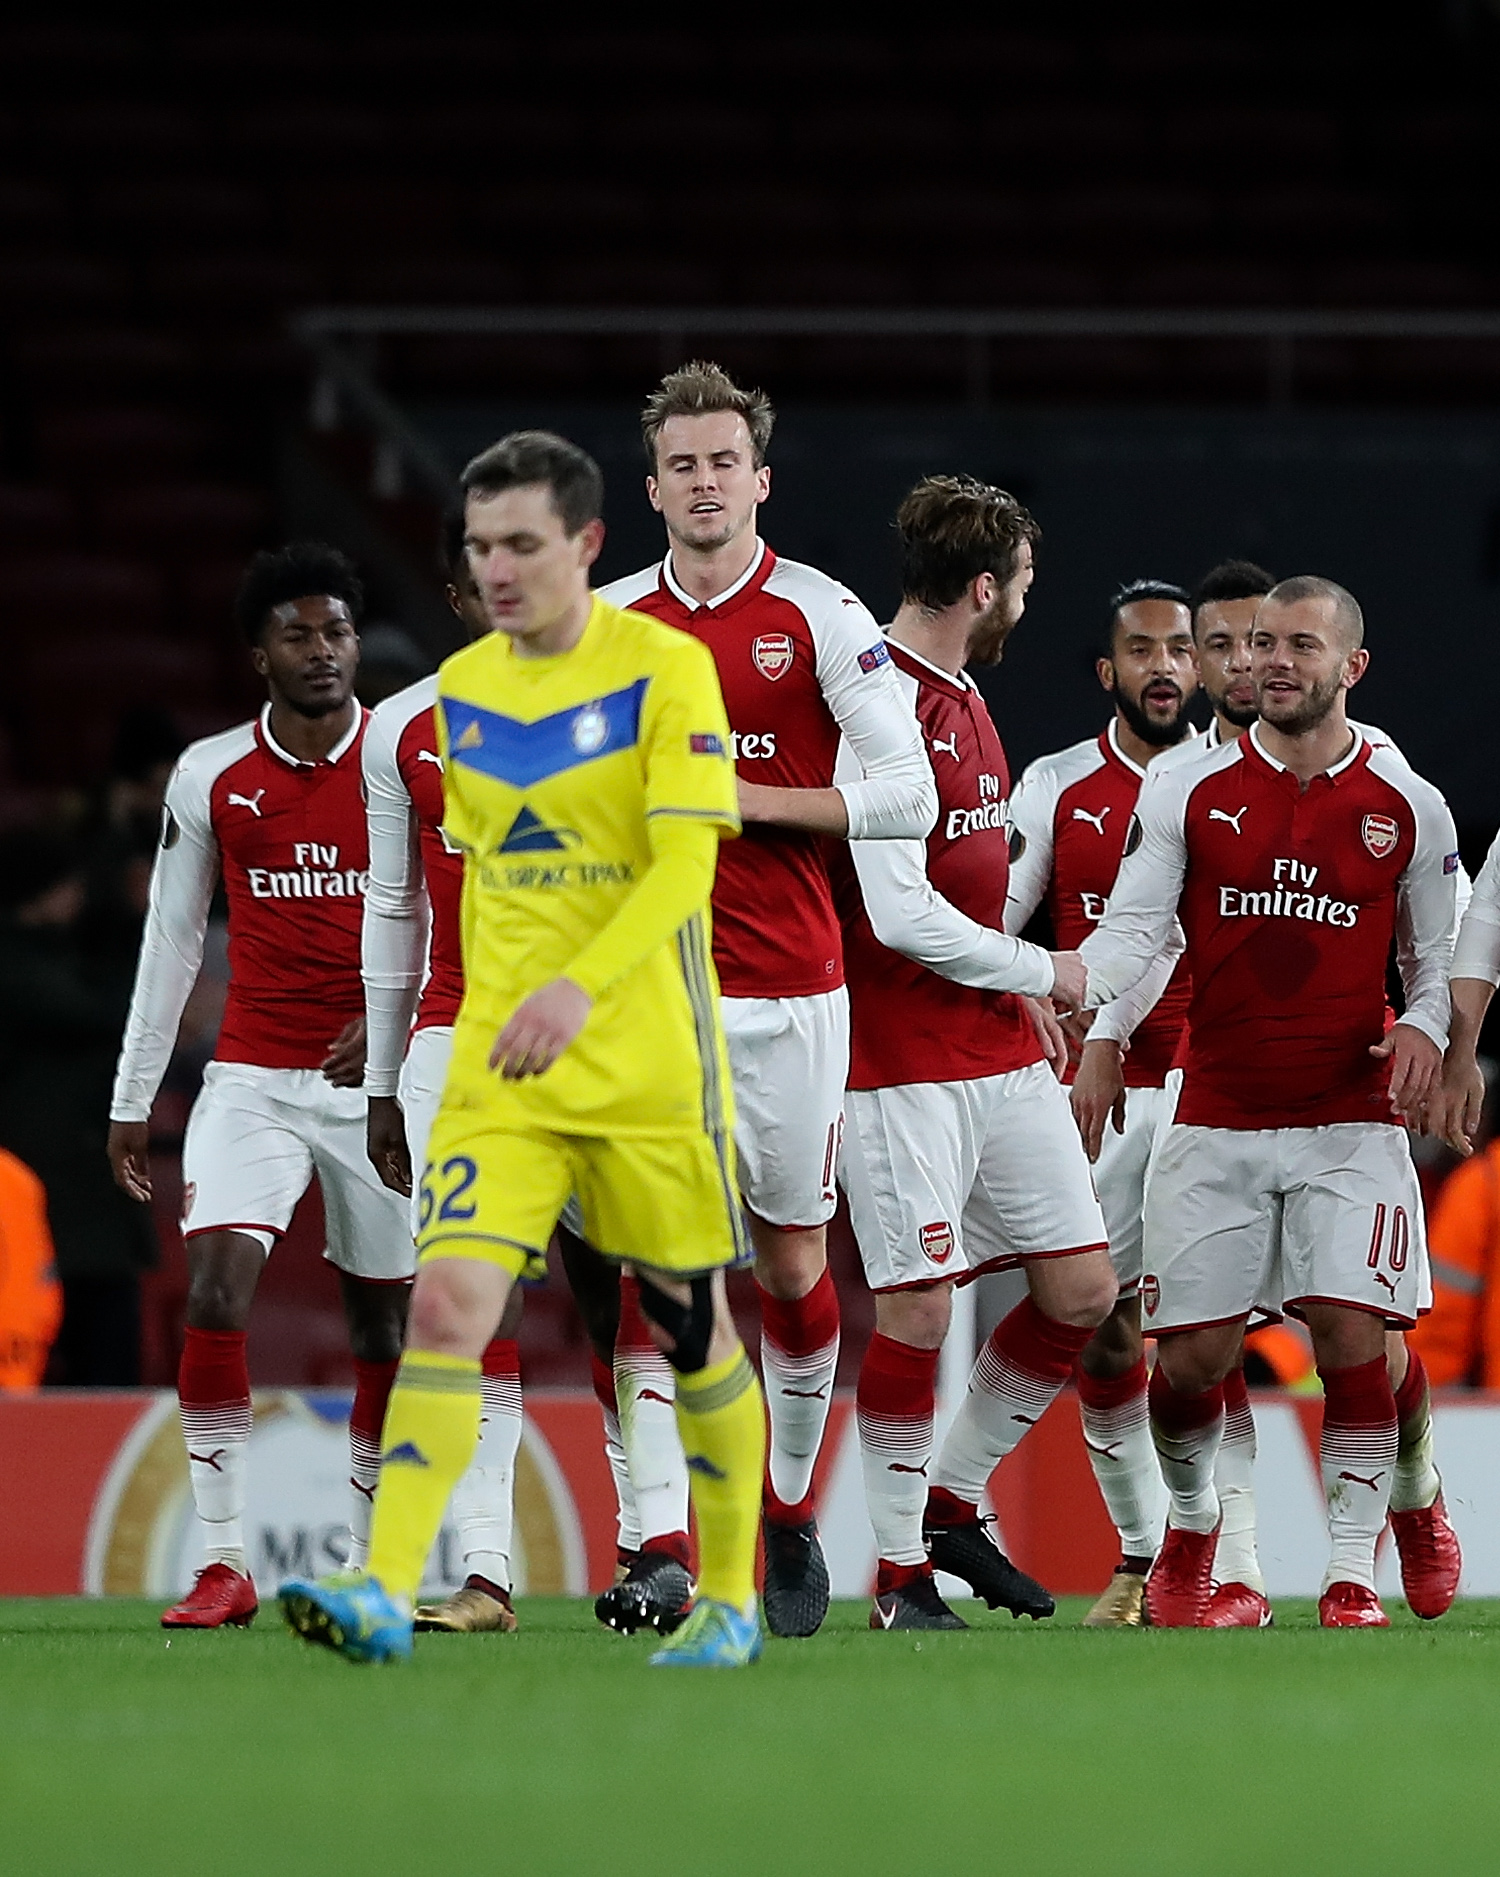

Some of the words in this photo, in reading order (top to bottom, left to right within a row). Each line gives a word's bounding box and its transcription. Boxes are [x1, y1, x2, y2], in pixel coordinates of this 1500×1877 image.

[978, 773, 999, 799] Fly
[945, 797, 1009, 840] Emirat
[292, 841, 338, 870] Fly
[247, 866, 371, 898] Emirate
[1273, 857, 1319, 889] Fly
[1218, 882, 1359, 929] Emirates
[1366, 1201, 1407, 1272] 10
